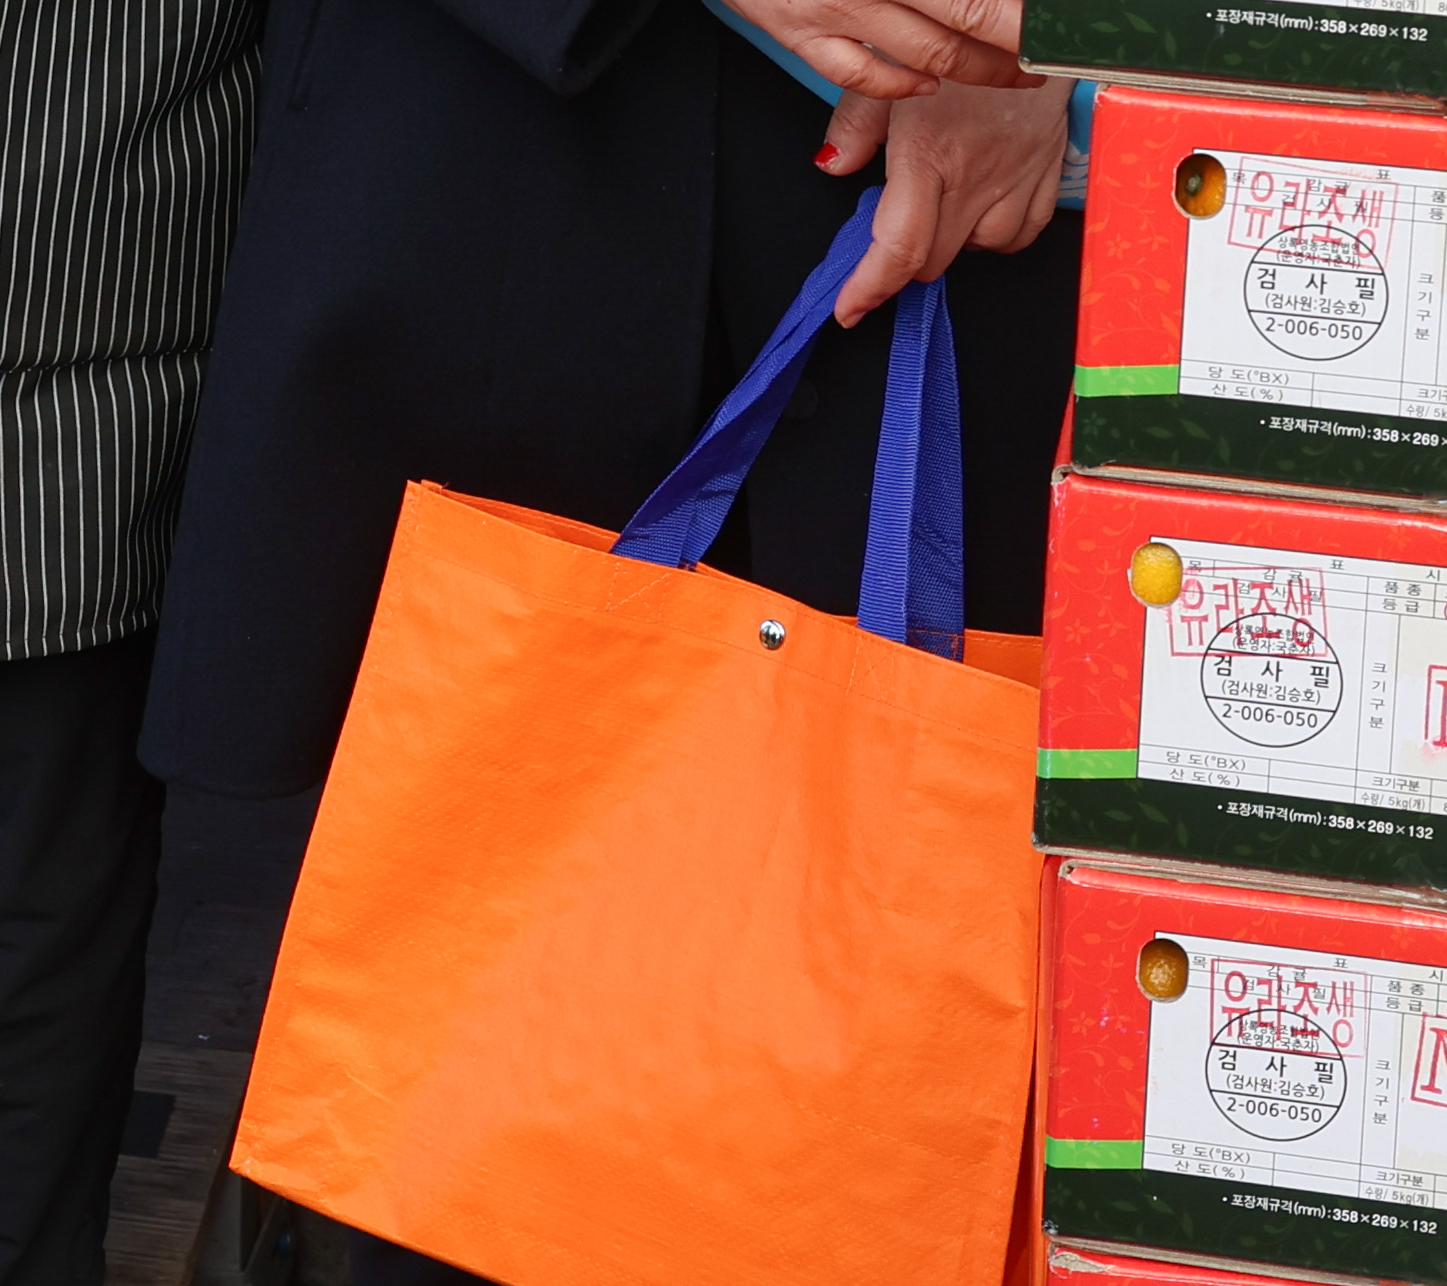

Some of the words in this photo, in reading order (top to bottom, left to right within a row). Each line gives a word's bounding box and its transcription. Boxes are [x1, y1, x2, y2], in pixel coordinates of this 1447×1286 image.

[1264, 317, 1364, 342] 2-006-050
[1222, 703, 1319, 729] 2-006-050
[1226, 1096, 1323, 1123] 2-006-050
